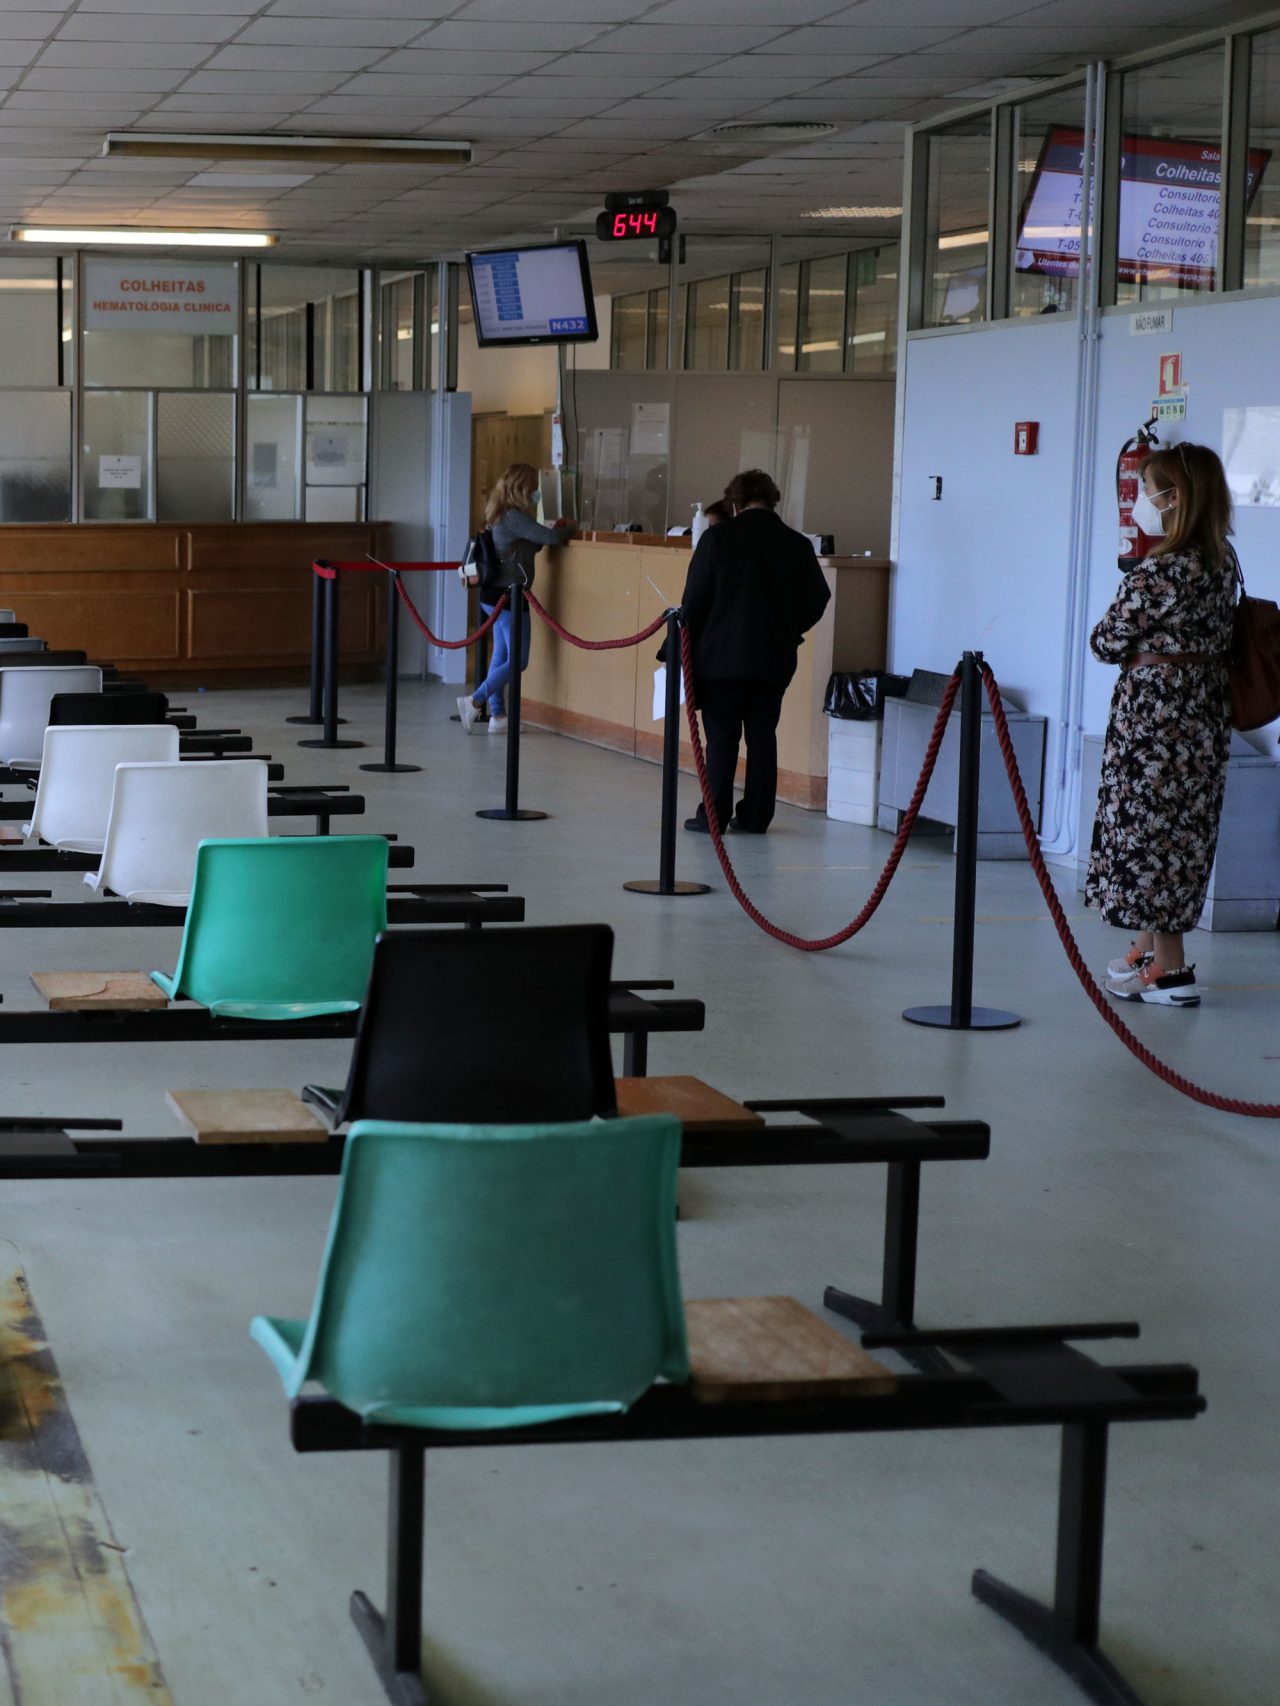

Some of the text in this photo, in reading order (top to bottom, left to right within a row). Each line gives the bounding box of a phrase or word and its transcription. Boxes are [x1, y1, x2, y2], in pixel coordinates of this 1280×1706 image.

[1201, 150, 1220, 161] Sala
[1156, 163, 1221, 183] Colheitas
[1153, 203, 1204, 217] Colheitas
[613, 213, 657, 237] 644
[1148, 217, 1211, 234] Consultorio
[1057, 238, 1081, 250] T-05
[1142, 232, 1205, 248] Consultorio
[1137, 247, 1186, 262] Colheitas
[120, 279, 206, 293] COLHEITAS
[93, 301, 231, 313] HEMATOLOGIA CLINICA
[551, 320, 585, 331] N432
